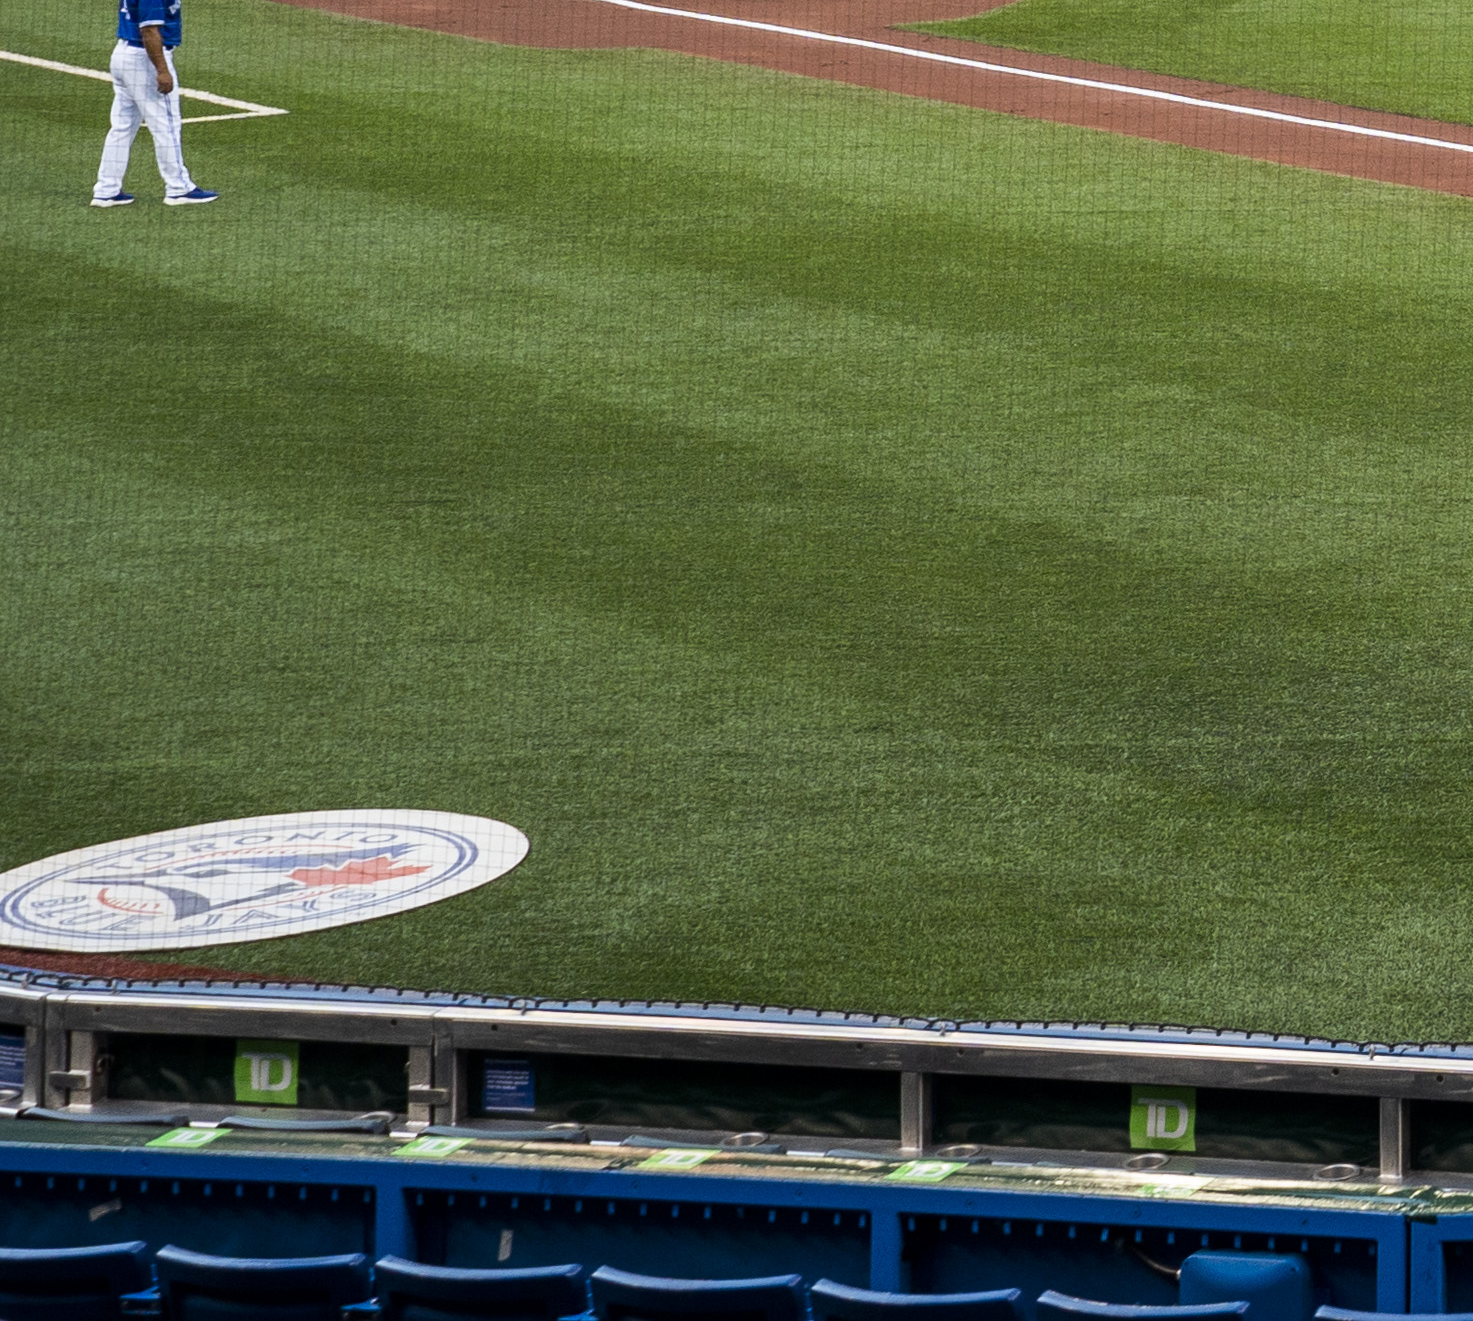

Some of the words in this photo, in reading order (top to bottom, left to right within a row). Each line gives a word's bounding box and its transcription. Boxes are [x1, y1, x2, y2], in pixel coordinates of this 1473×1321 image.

[94, 830, 399, 873] TORONTO
[31, 894, 142, 931] BLUE
[186, 889, 377, 928] JAYS
[242, 1052, 292, 1092] TD
[170, 1130, 218, 1144] TD
[1139, 1098, 1189, 1139] TD
[415, 1138, 463, 1153] TD
[659, 1150, 709, 1168] TD
